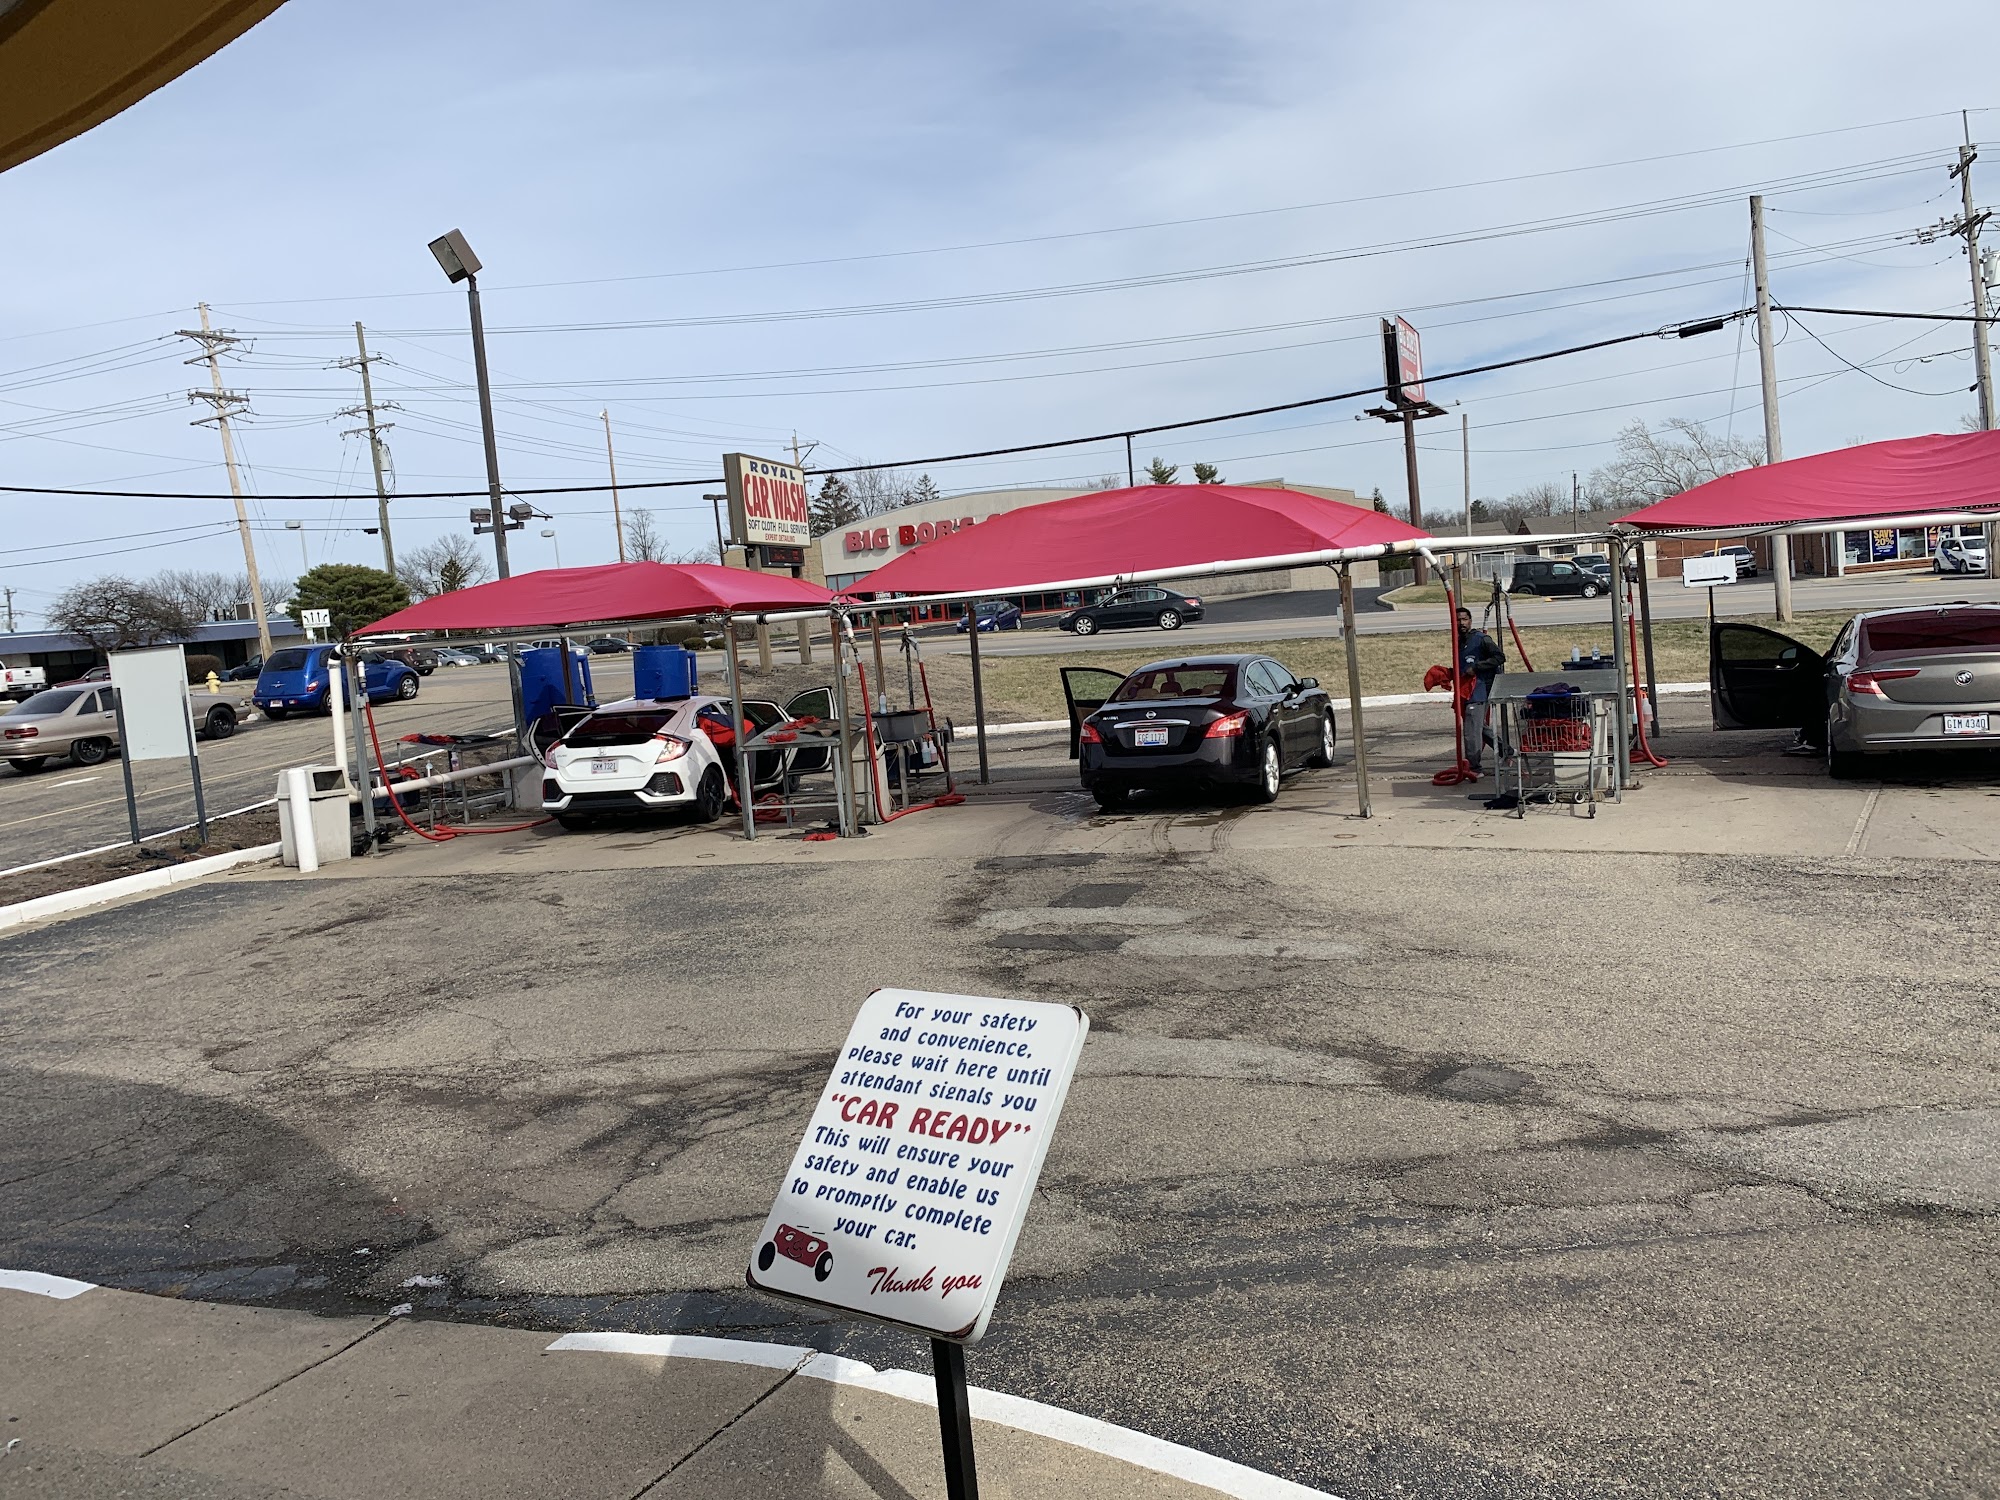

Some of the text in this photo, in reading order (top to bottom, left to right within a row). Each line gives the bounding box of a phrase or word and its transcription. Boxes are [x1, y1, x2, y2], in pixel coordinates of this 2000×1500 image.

[750, 461, 795, 480] ROYAL
[744, 473, 807, 523] CAR WASH
[748, 519, 807, 535] SOFT CLOTH FULL SERVICE
[765, 533, 795, 542] EXPERT DETAILING
[845, 528, 890, 552] BIG
[1873, 530, 1894, 539] SAVE
[1875, 537, 1894, 546] 20%
[895, 1001, 1037, 1032] For your safety
[880, 1026, 1033, 1059] and convenience,
[848, 1046, 1051, 1087] please wait here until
[840, 1069, 1037, 1113] attendant signals you
[814, 1126, 1013, 1179] This will ensure your
[804, 1153, 1000, 1207] safety and enable us
[791, 1177, 993, 1236] to promptly complete
[833, 1217, 917, 1250] your car.
[867, 1266, 982, 1299] Thank you
